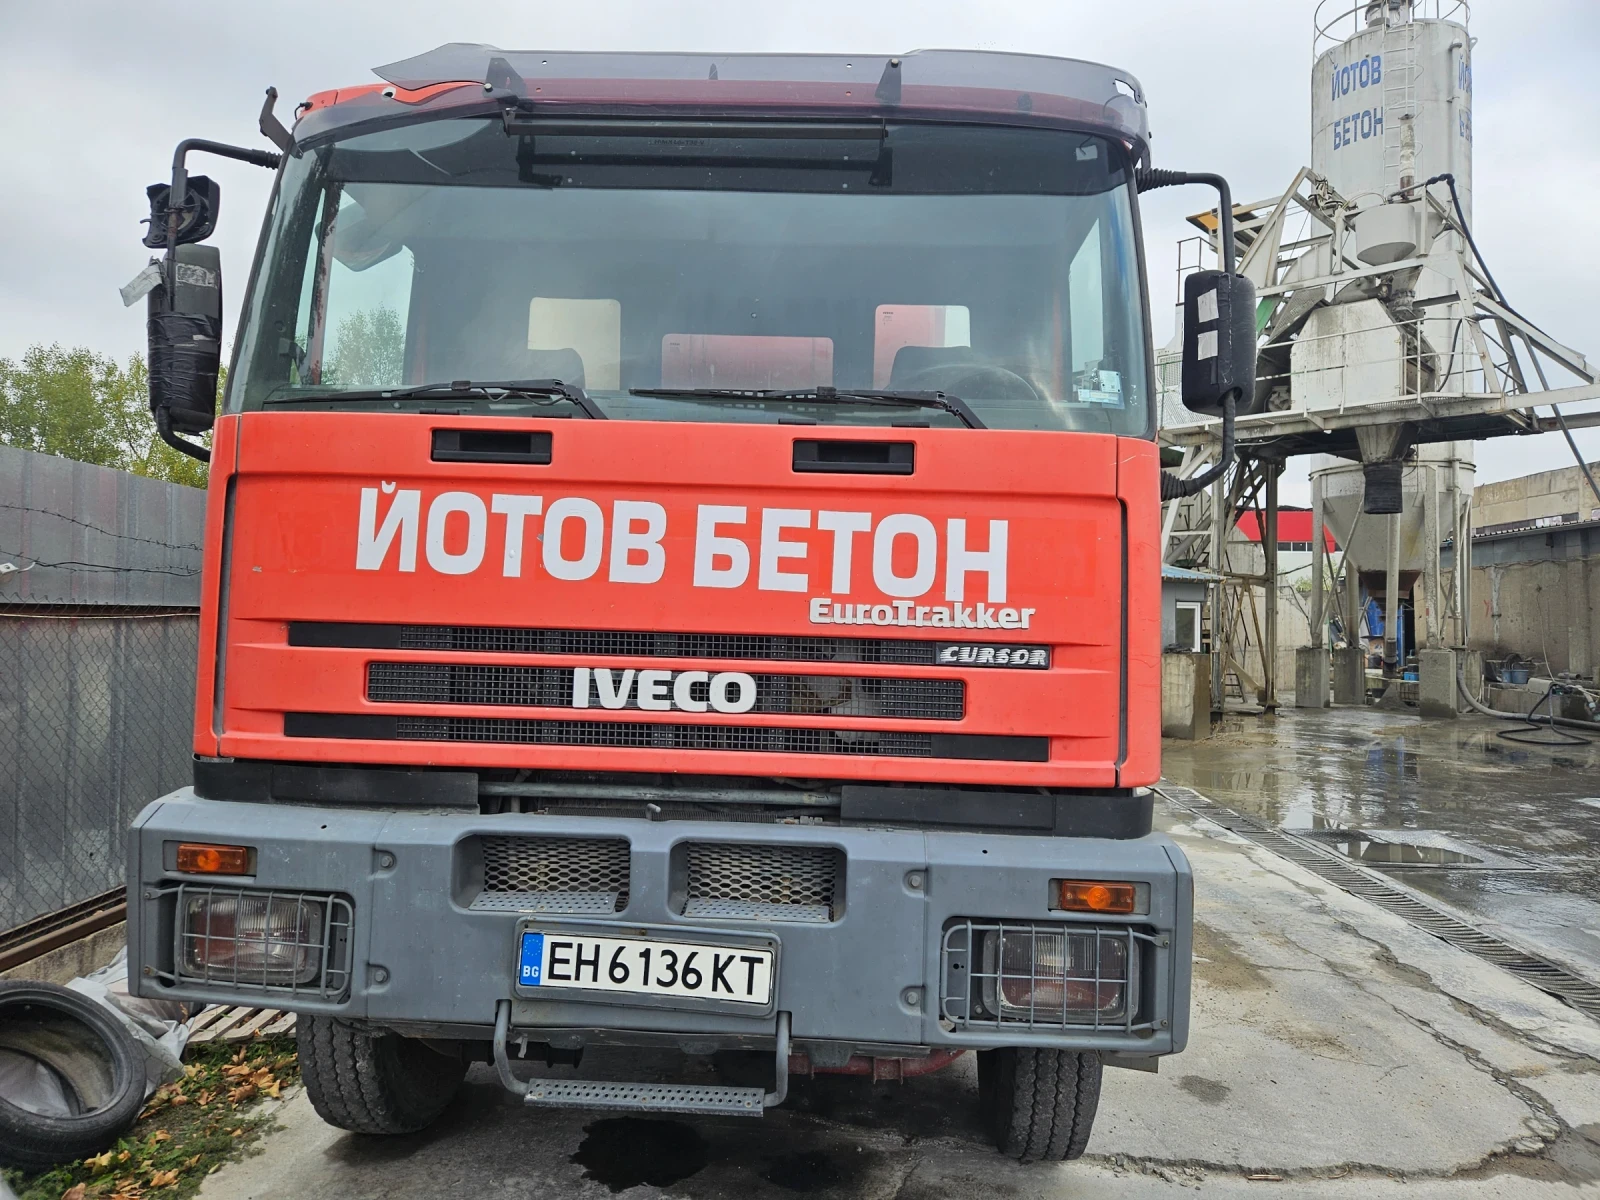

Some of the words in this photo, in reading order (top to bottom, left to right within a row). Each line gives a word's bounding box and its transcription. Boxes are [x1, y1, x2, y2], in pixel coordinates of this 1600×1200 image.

[1331, 55, 1382, 101] ЙОТОВ
[1333, 106, 1384, 150] БЕТОН
[355, 480, 667, 585] ЙОТОВ
[692, 504, 1009, 604] БЕТОН
[809, 597, 1036, 629] EuroTrakker
[939, 645, 1047, 667] CURSOR
[572, 667, 757, 714] IVECO
[522, 965, 540, 978] BG
